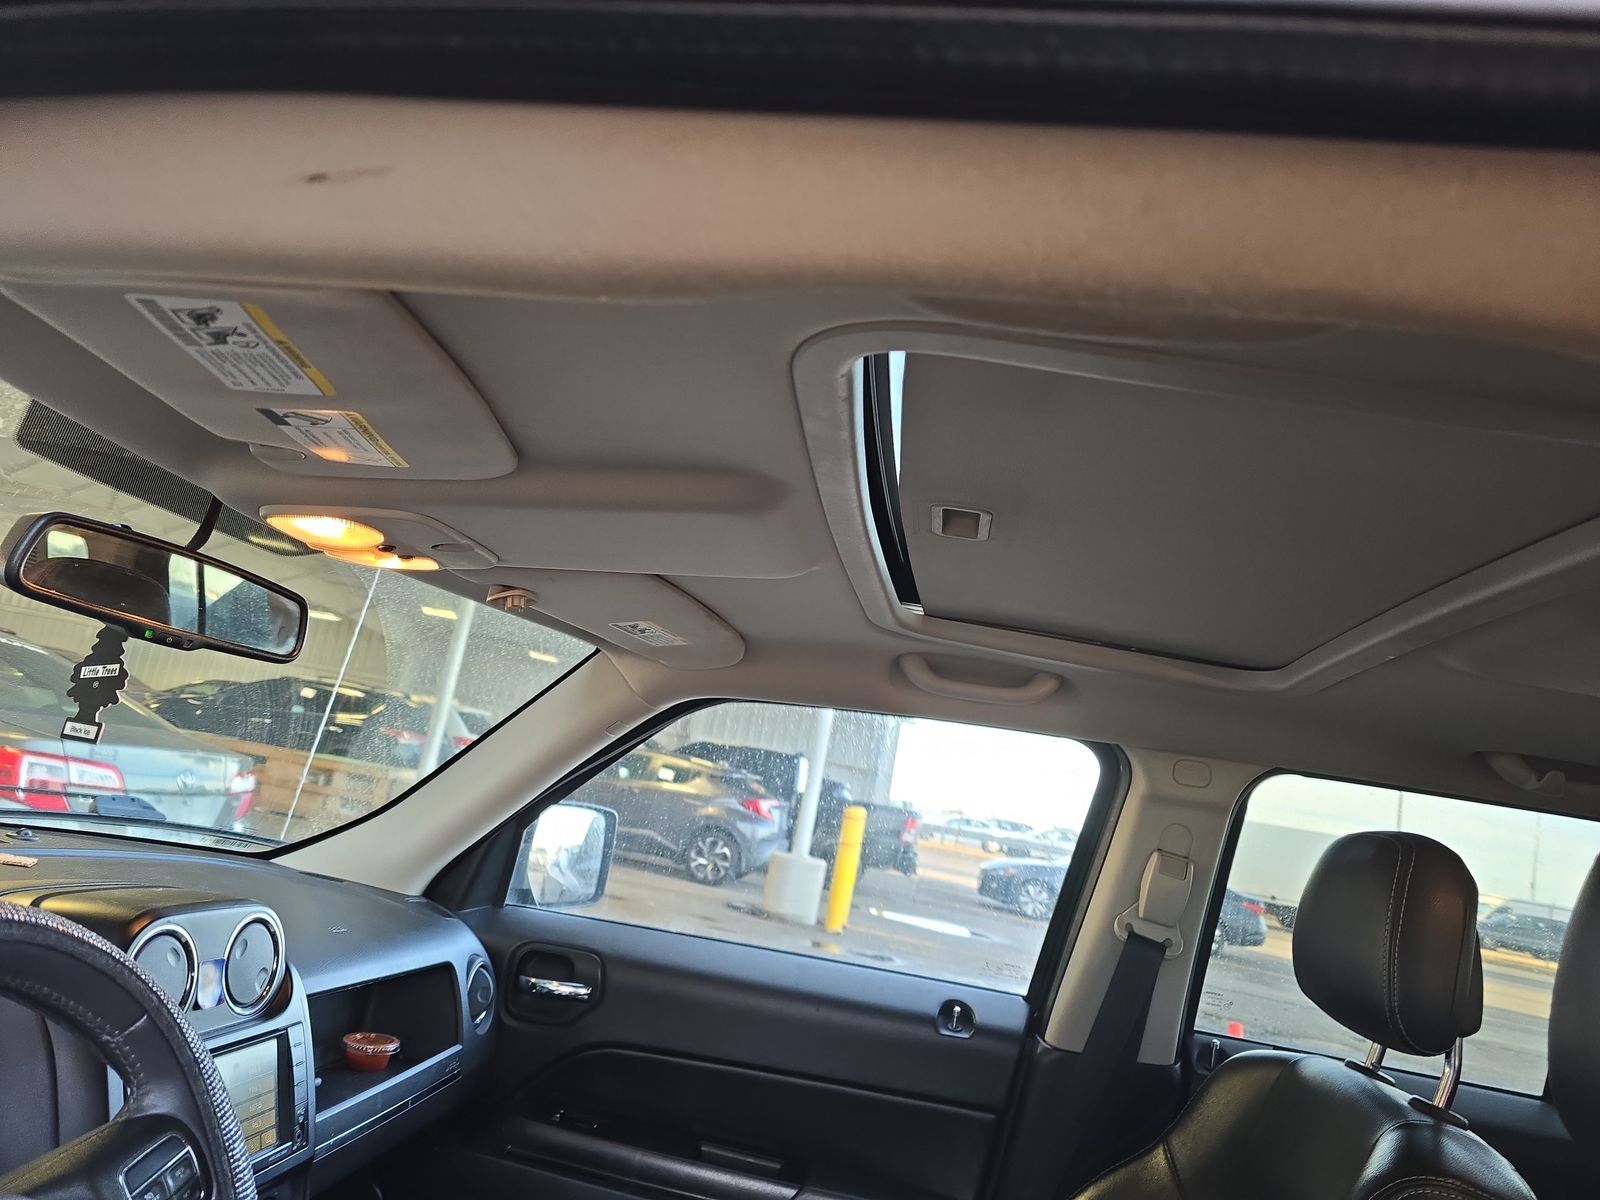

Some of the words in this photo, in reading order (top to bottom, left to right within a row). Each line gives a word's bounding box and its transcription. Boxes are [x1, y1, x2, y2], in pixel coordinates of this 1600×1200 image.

[83, 666, 100, 677] Little
[101, 666, 118, 676] Trees
[70, 725, 83, 735] Black
